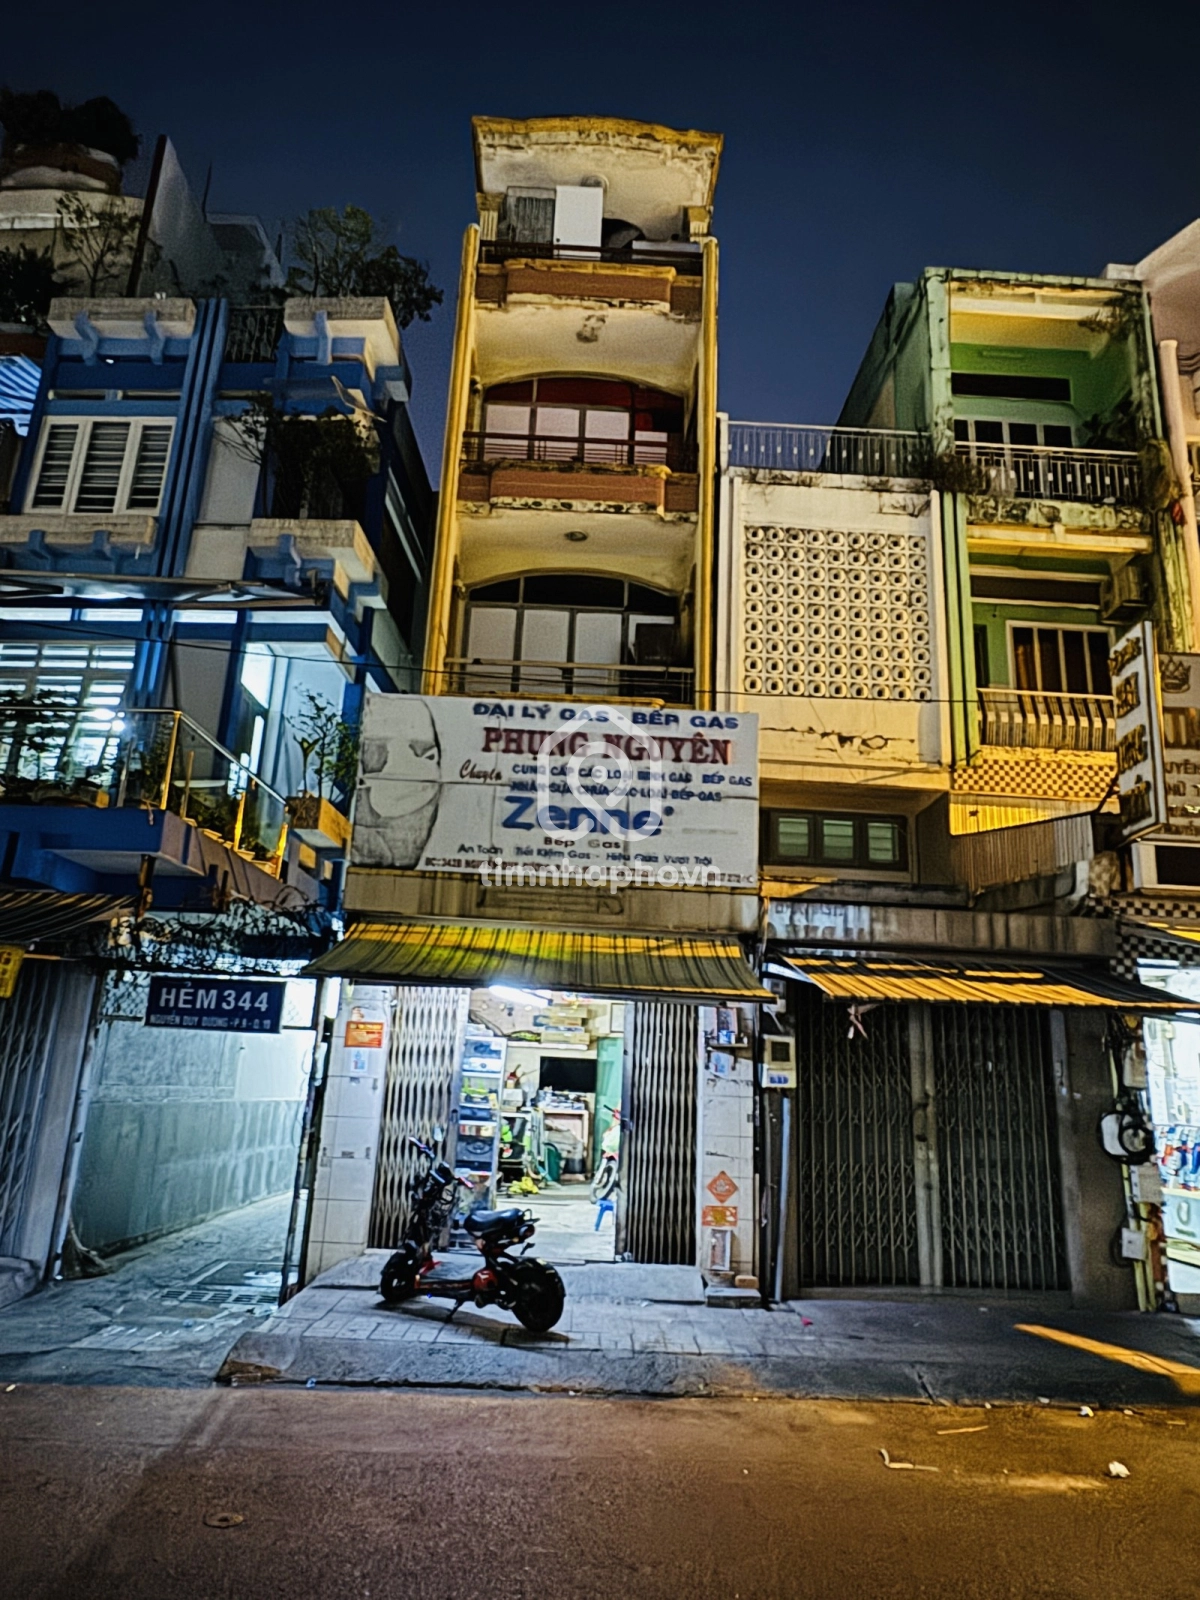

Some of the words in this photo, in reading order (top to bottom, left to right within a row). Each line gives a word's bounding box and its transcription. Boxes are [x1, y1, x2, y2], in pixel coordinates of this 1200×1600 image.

[521, 703, 552, 720] LÝ
[559, 707, 610, 722] GAS
[631, 709, 680, 726] BẾP
[689, 715, 740, 729] GAS
[481, 726, 589, 761] PHỤNG
[602, 731, 732, 766] NGUYÊN
[511, 763, 547, 775] CUNG
[668, 771, 693, 784] GAS
[728, 775, 753, 787] GAS
[697, 790, 722, 802] GAS
[501, 795, 663, 837] Zenne
[457, 843, 474, 854] An
[477, 844, 503, 856] Toàn
[567, 849, 591, 860] Gas
[543, 836, 576, 848] Bếp
[587, 838, 621, 849] Gas
[158, 981, 218, 1009] HẺM
[221, 990, 269, 1012] 344
